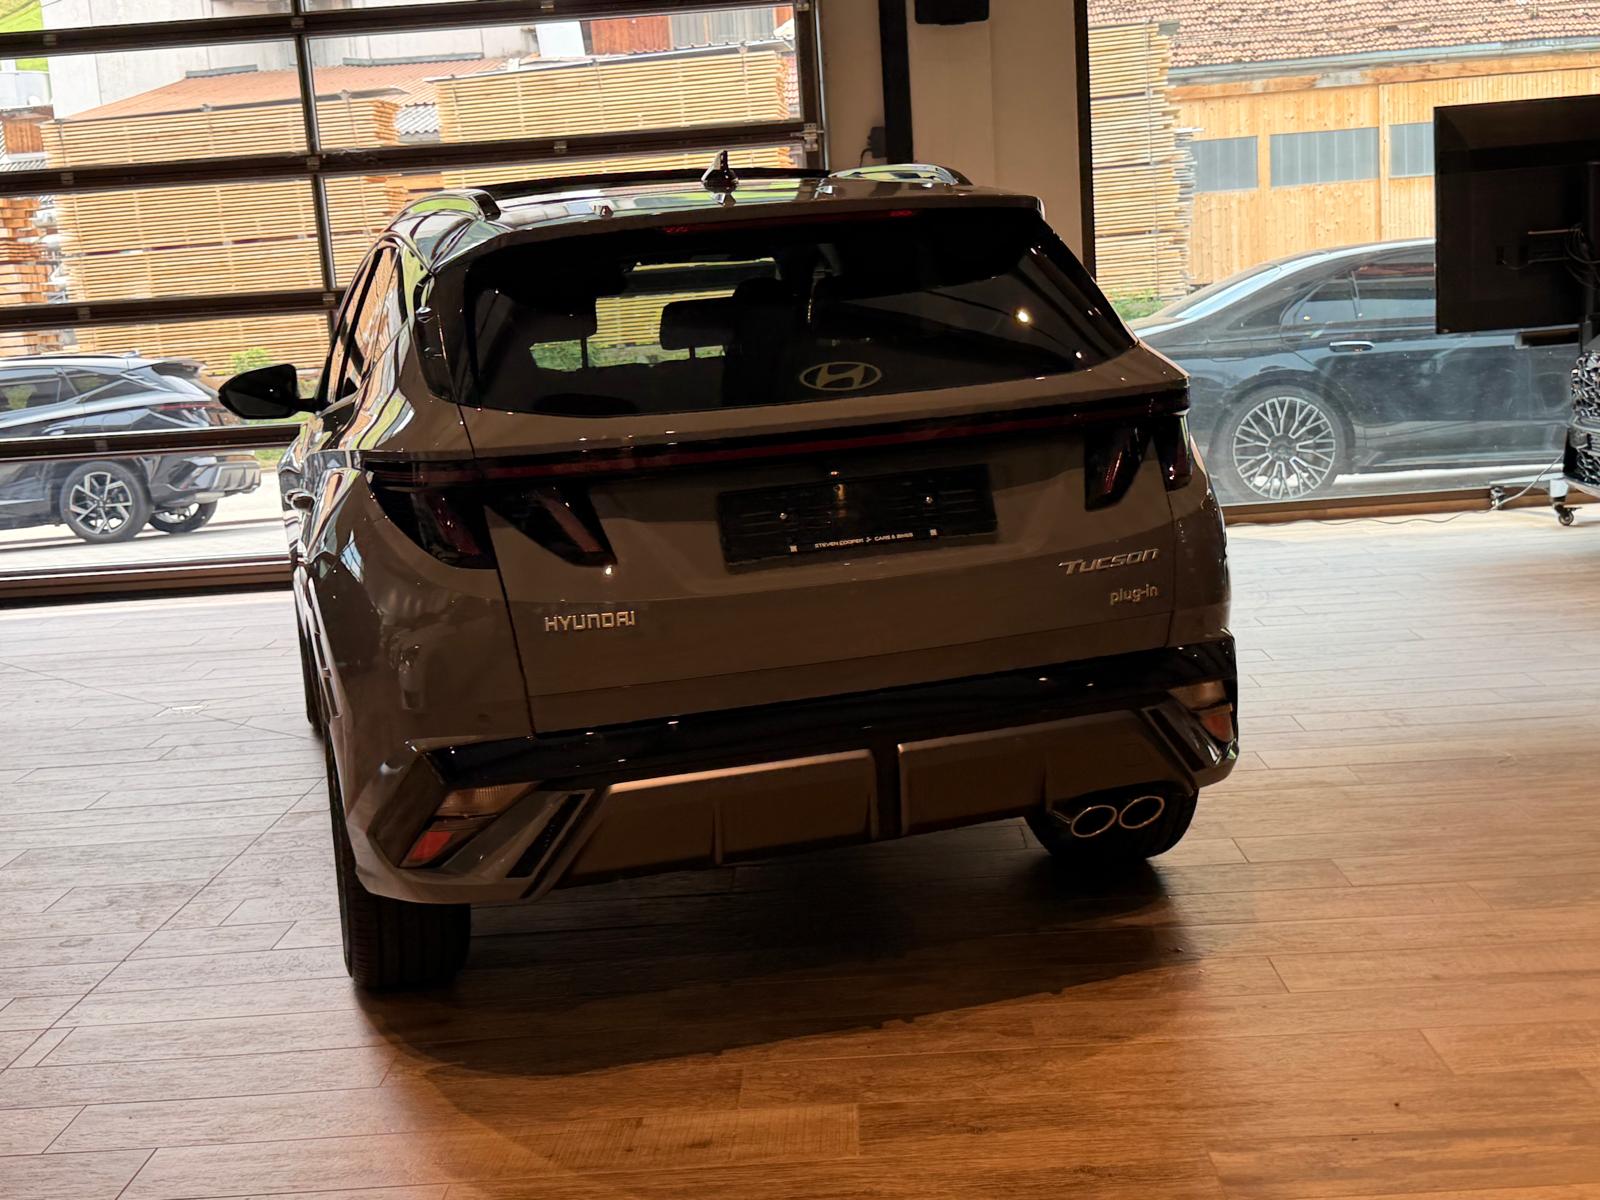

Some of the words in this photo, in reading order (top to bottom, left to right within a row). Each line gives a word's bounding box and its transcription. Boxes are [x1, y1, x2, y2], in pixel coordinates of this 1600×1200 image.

[1058, 548, 1159, 575] TUCSON
[1110, 583, 1159, 606] plug-in
[544, 610, 635, 632] HYUNDAI
